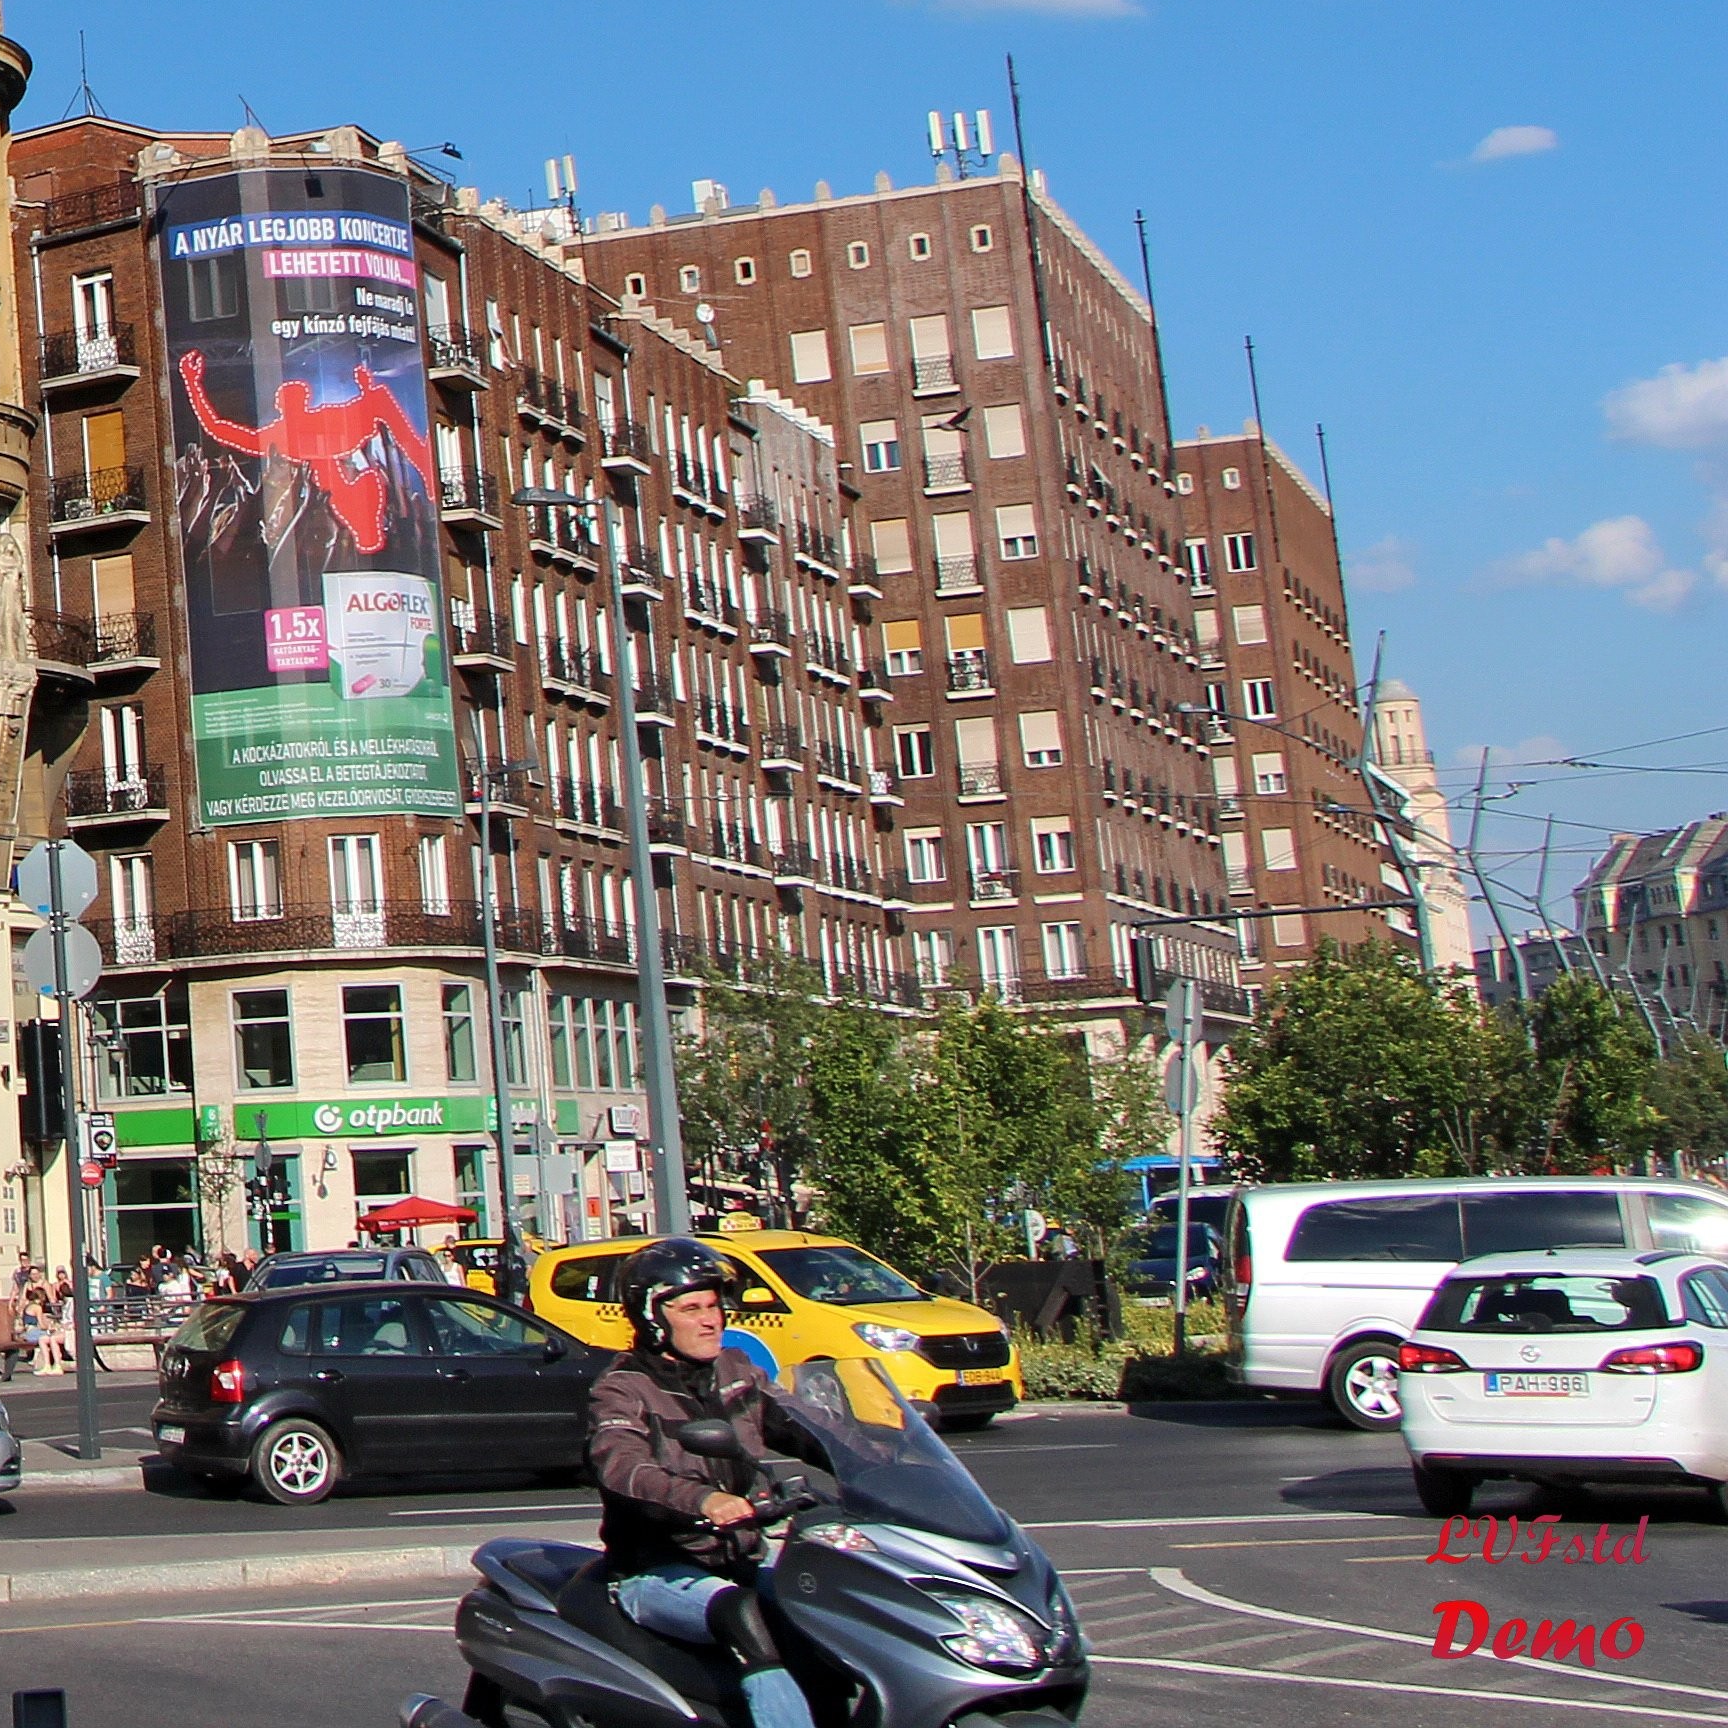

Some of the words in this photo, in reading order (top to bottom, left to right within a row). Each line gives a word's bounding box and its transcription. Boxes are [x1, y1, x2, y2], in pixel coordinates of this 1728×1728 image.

[175, 232, 189, 256] A
[193, 218, 243, 252] NYÁR
[249, 218, 335, 243] LEGJOBB
[340, 217, 409, 252] KONCERTJE
[269, 251, 361, 275] LEHETETT
[356, 287, 373, 307] Ne
[272, 321, 300, 339] egy
[304, 315, 346, 335] kínzó
[349, 316, 390, 338] fejfájás
[347, 592, 429, 613] ALGOFLEX
[270, 611, 321, 640] 1,5x
[410, 617, 433, 632] FORTE
[379, 678, 392, 689] 30
[231, 749, 241, 765] A
[242, 736, 332, 763] KOCKÁZATOKRÓL
[334, 739, 348, 757] ÉS
[350, 745, 358, 756] A
[259, 767, 309, 788] OLVASSA
[310, 767, 325, 784] EL
[326, 767, 334, 783] A
[206, 799, 233, 817] VAGY
[234, 790, 290, 815] KÉRDEZZE
[291, 791, 316, 809] MEG
[349, 1102, 443, 1134] otpbank
[1500, 1374, 1583, 1393] PAH-986
